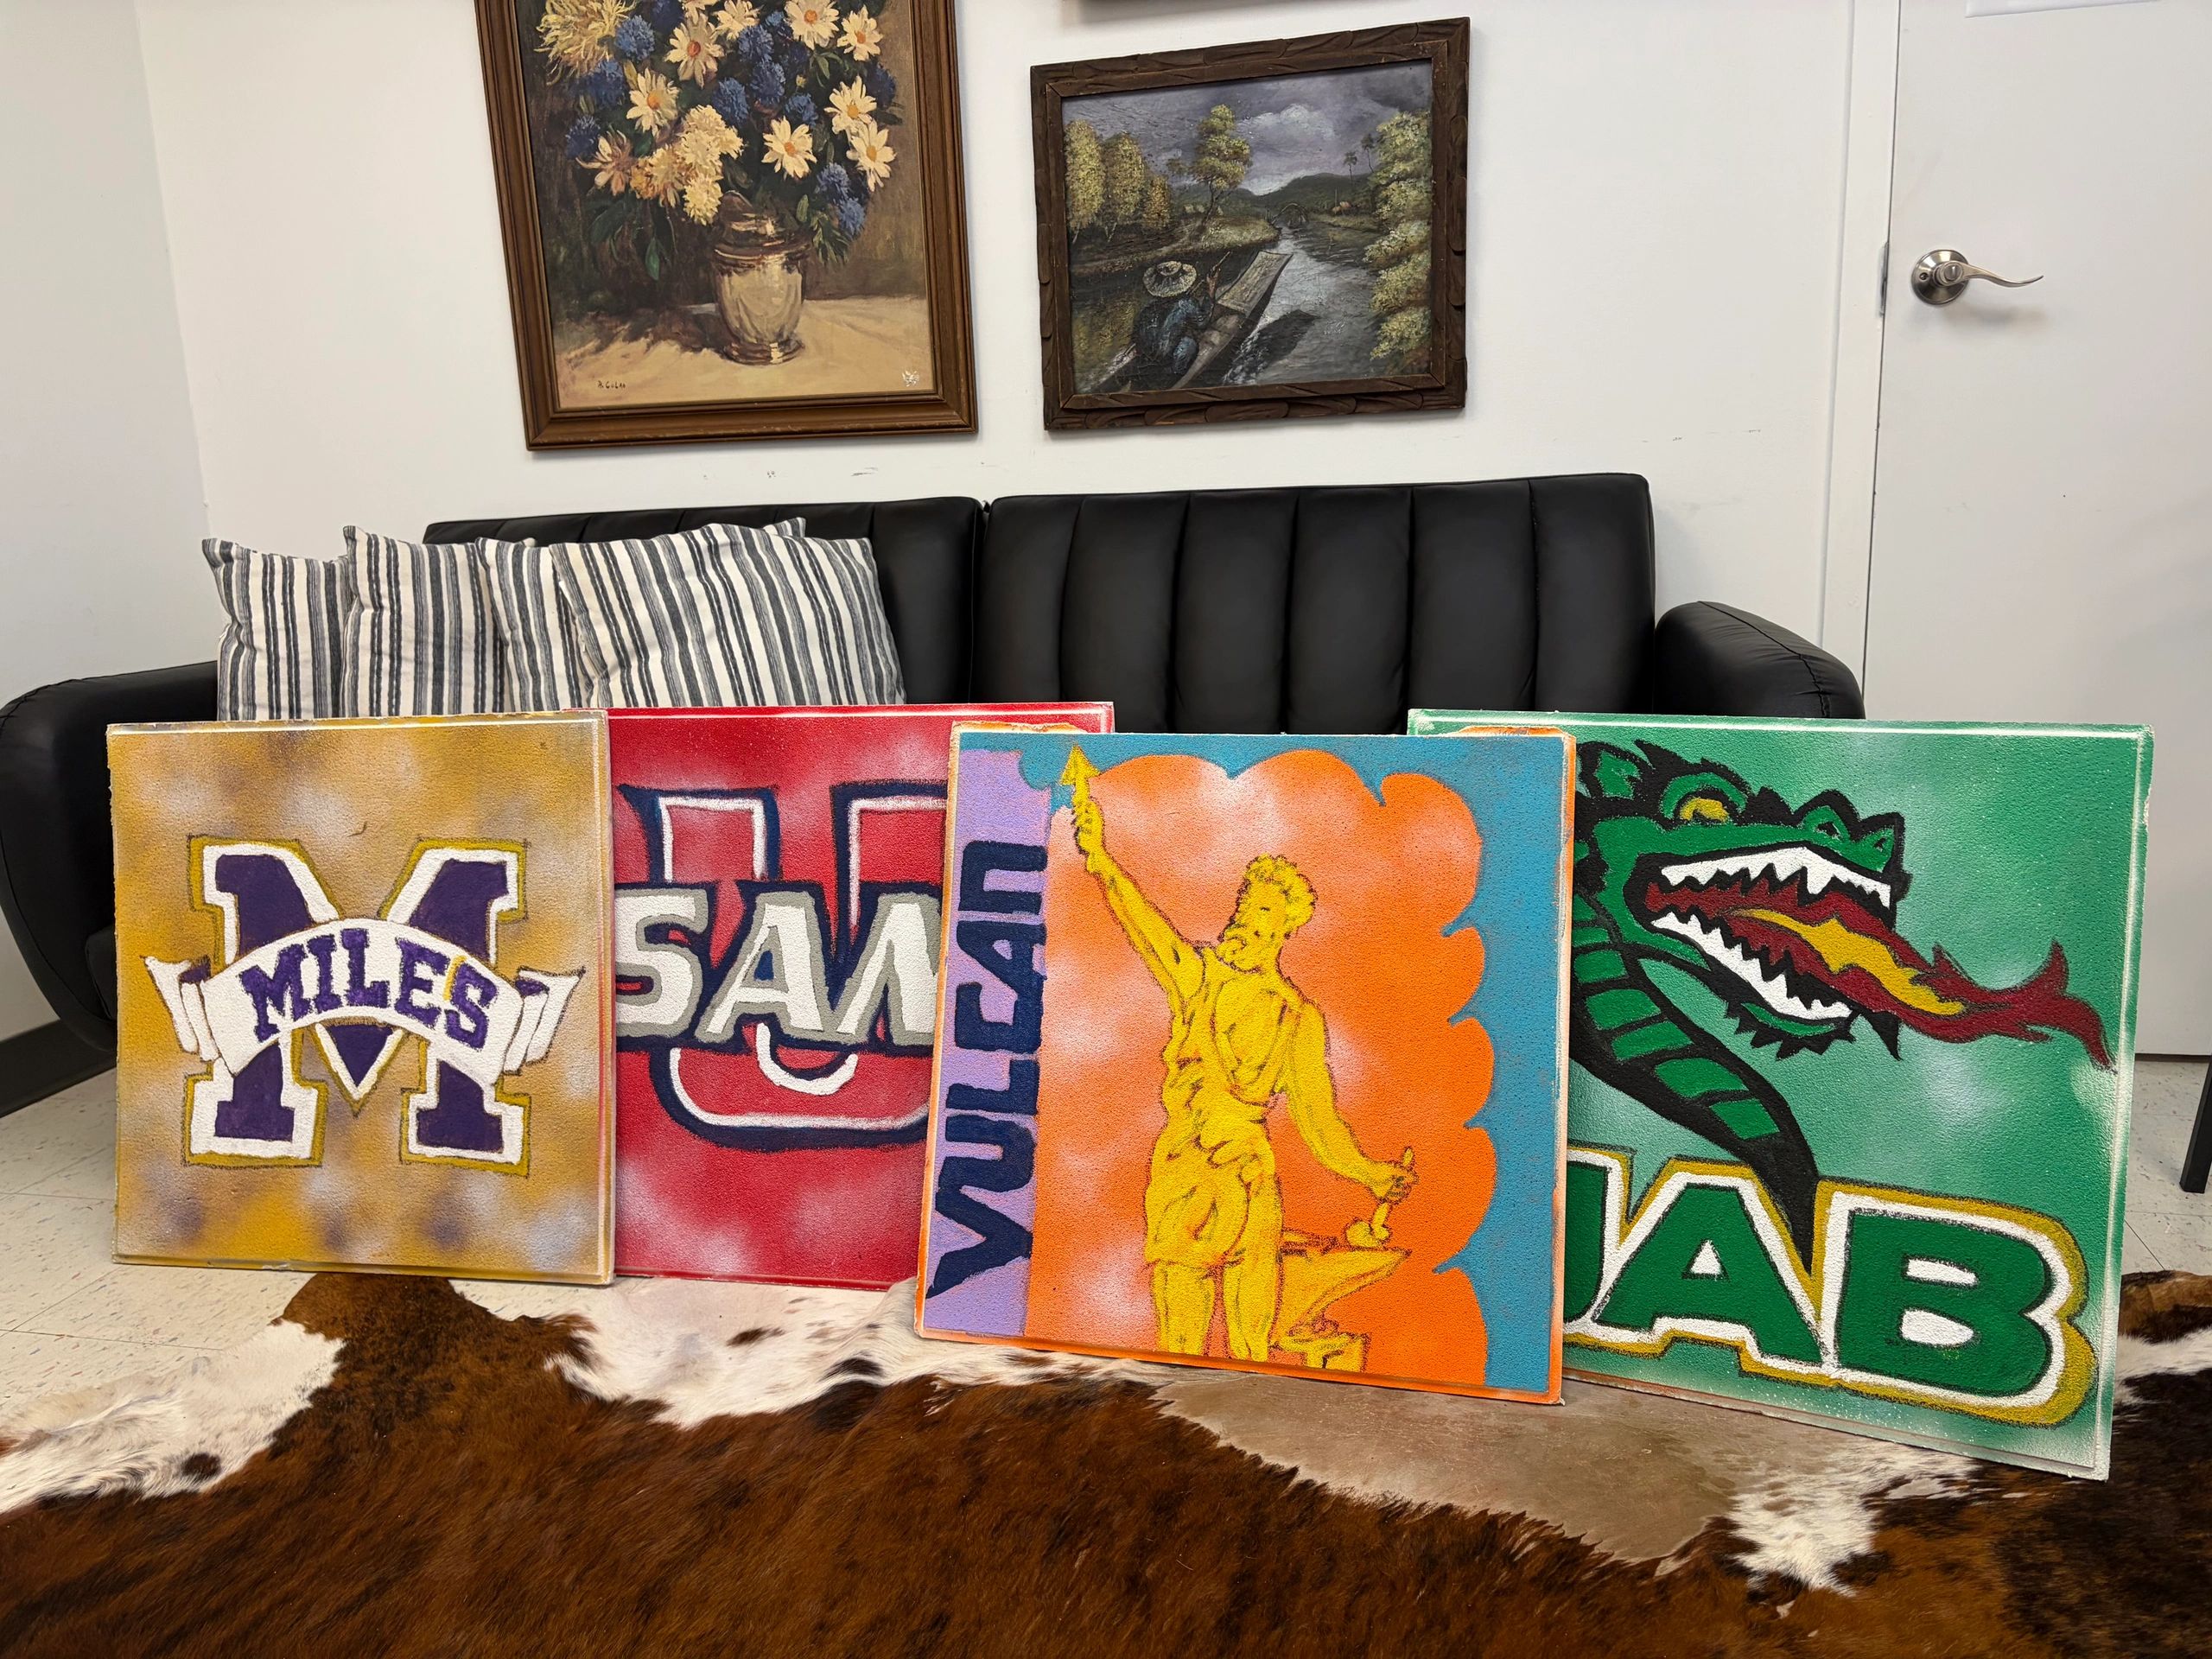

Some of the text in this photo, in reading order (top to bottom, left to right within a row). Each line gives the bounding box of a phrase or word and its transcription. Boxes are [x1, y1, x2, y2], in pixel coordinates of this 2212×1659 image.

[184, 836, 533, 1176] M
[238, 927, 499, 1050] MILES
[926, 840, 1048, 1298] VULCAN
